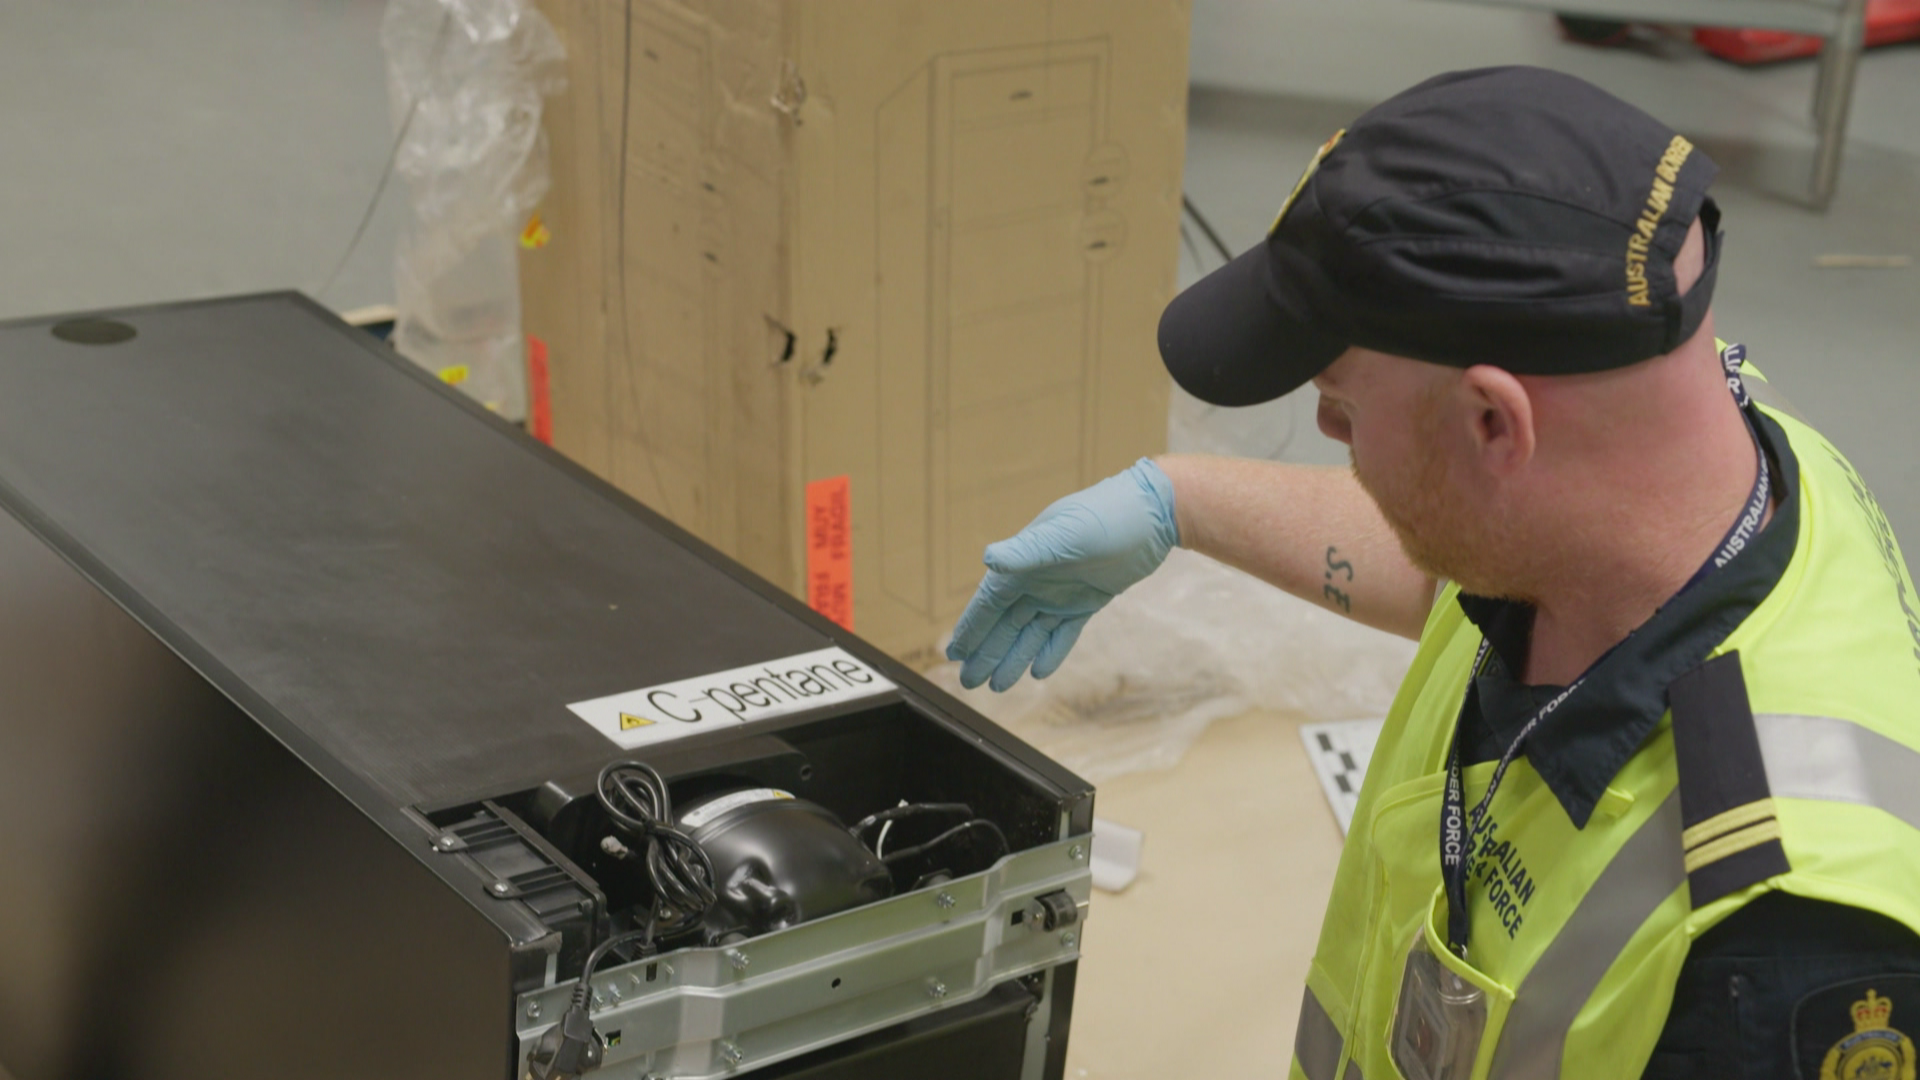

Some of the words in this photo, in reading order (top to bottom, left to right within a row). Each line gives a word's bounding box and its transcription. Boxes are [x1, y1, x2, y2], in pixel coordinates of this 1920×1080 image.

[1626, 177, 1674, 307] AUSTRALIAN
[1714, 473, 1768, 568] AUSTRALIAN
[647, 659, 873, 723] C-pentane
[1445, 805, 1461, 866] FORCE
[1468, 805, 1535, 908] AUSRALIAN
[1483, 865, 1523, 941] FORCE
